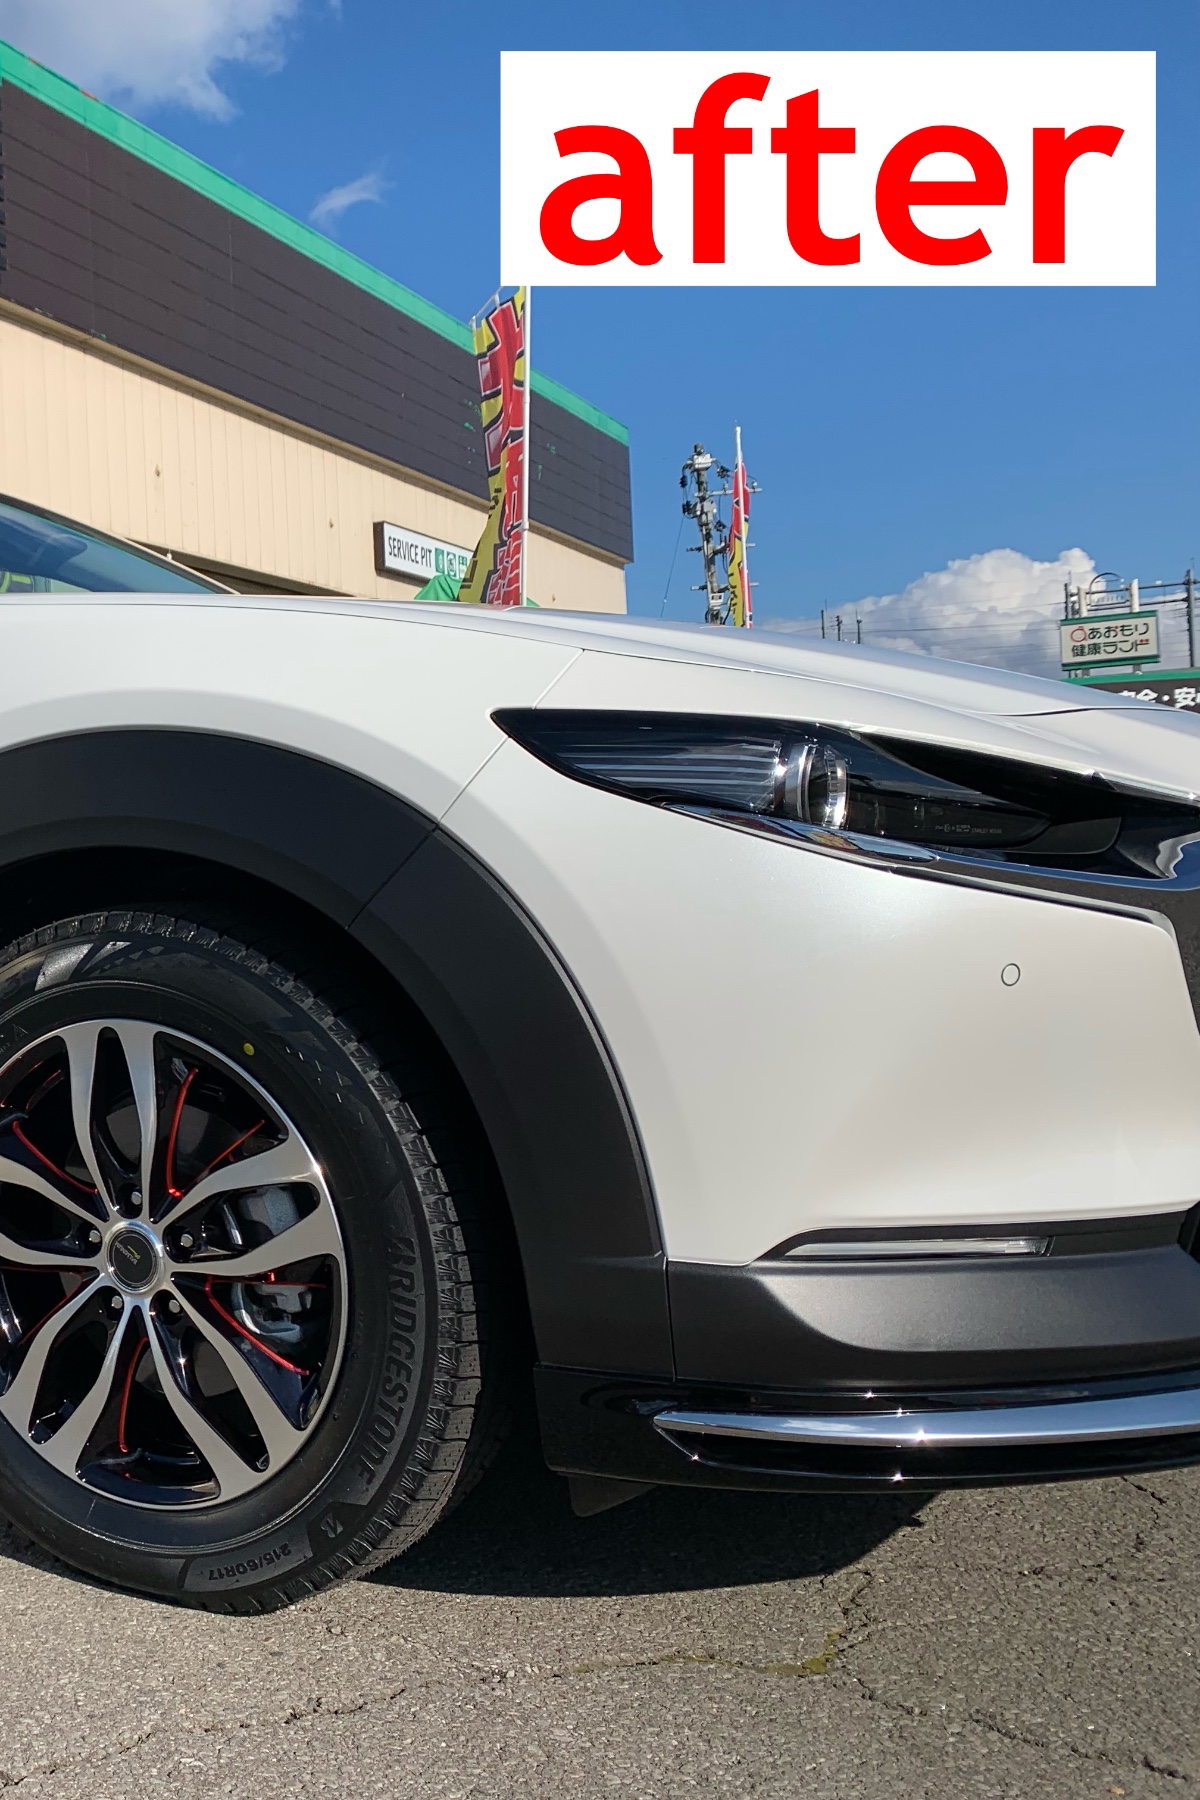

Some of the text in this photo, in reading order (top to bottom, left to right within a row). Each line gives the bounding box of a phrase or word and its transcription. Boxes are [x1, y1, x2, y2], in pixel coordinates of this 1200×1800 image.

[388, 536, 432, 568] SERVICE PIT
[1088, 622, 1150, 640] あおもり
[1071, 638, 1150, 657] 健康ランド
[358, 1237, 418, 1487] BRIDGESTONE
[208, 1542, 292, 1581] 215/60R17
